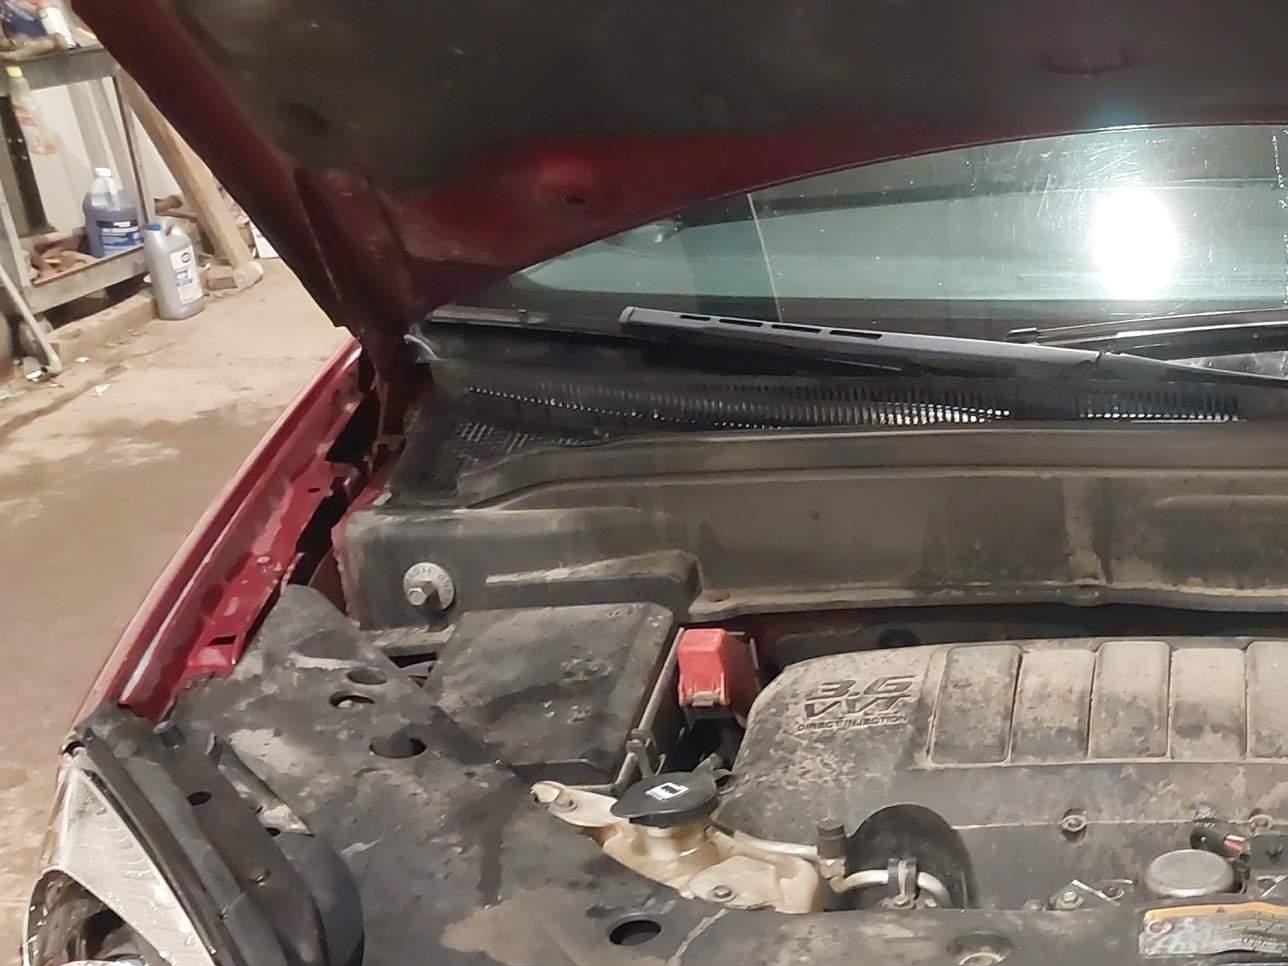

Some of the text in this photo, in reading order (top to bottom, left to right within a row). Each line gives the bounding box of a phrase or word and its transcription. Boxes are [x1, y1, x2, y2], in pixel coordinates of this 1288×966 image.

[806, 675, 918, 702] 3.6
[804, 694, 912, 719] VVT
[796, 713, 908, 733] DIRECT INJECTION
